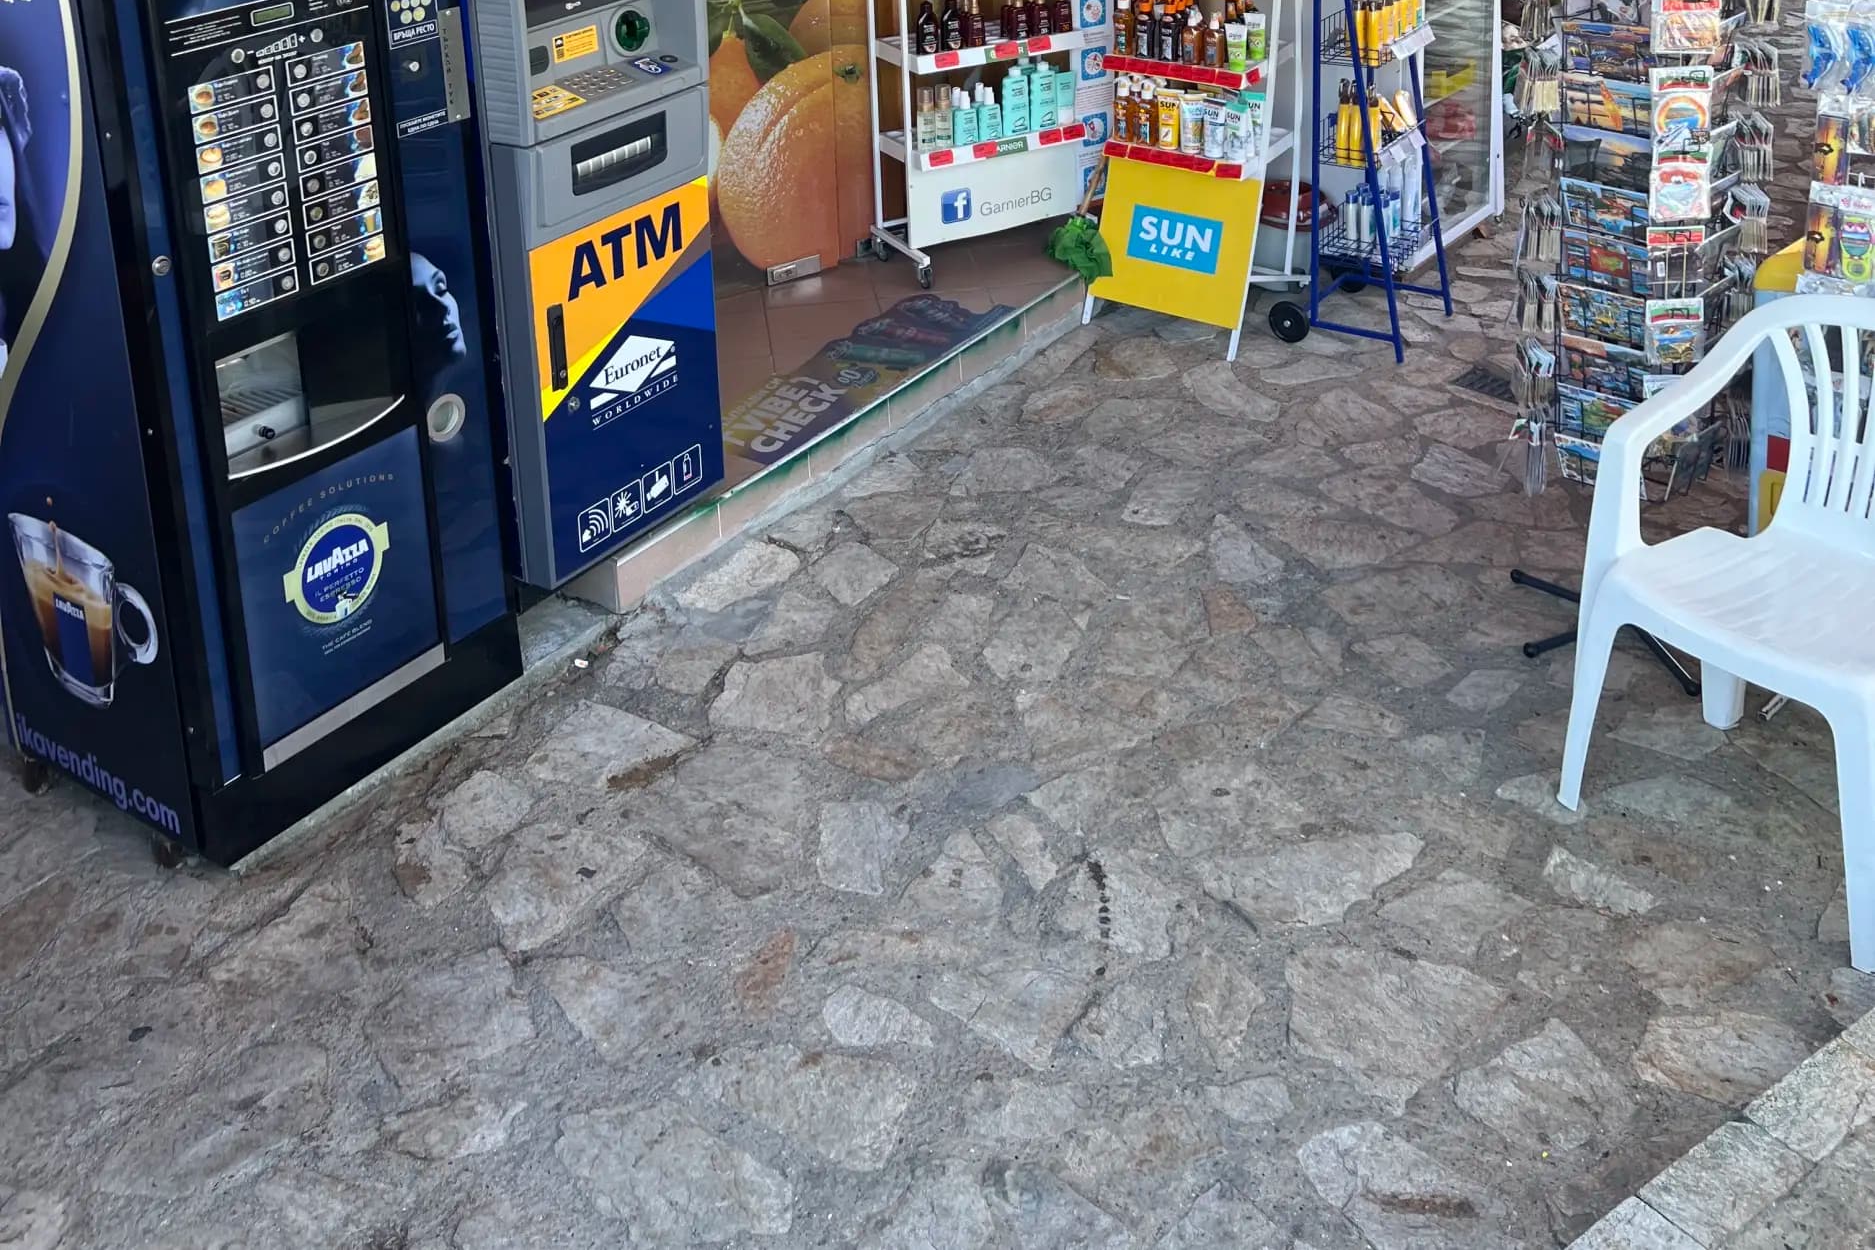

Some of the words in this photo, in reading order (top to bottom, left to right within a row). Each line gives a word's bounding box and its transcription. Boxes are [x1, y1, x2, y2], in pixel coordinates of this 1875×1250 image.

[416, 23, 435, 35] РЕСТО
[1204, 108, 1219, 118] SUN
[1226, 112, 1241, 121] SUN
[997, 140, 1024, 152] ARNIER
[979, 186, 1053, 218] GarnierBG
[568, 201, 683, 303] ATM
[1139, 215, 1214, 254] SUN
[1149, 243, 1196, 261] LIKE
[603, 346, 664, 387] Euronet
[592, 373, 679, 427] WORLDWIDE
[750, 382, 850, 453] CHECK
[263, 498, 313, 544] COFFEE
[319, 473, 394, 499] SOLUTIONS
[306, 538, 370, 583] LAVAZZA
[55, 597, 85, 620] LAVAZZA
[15, 712, 181, 835] ikavending.com
